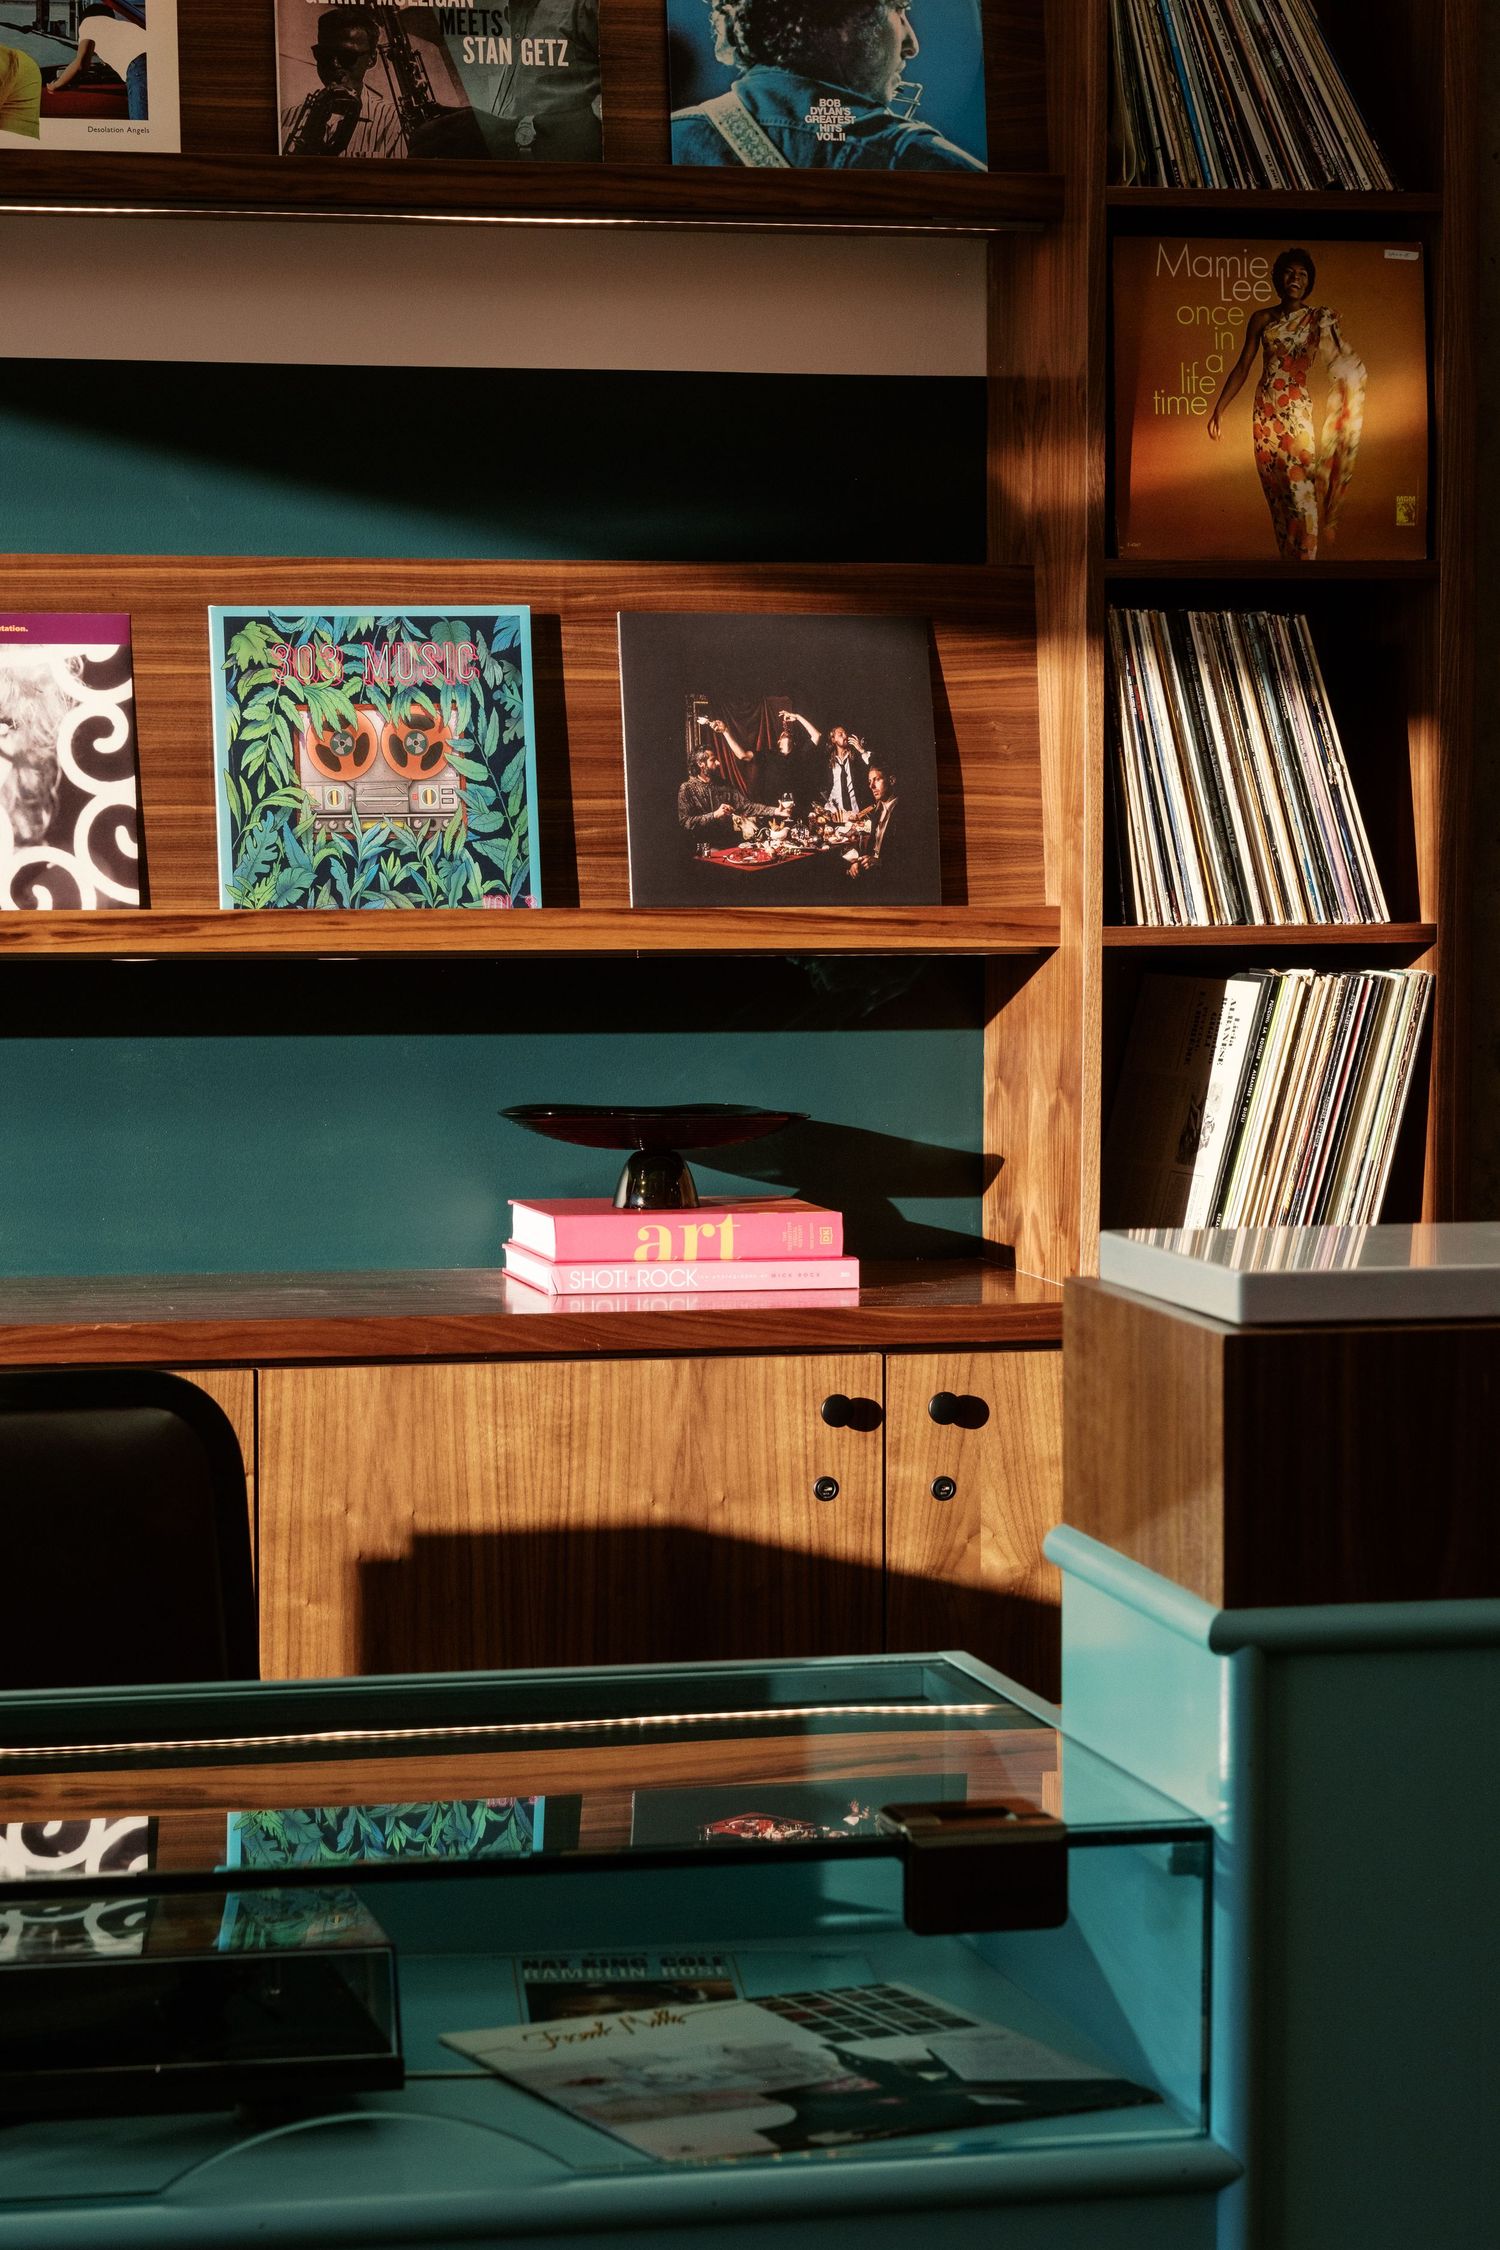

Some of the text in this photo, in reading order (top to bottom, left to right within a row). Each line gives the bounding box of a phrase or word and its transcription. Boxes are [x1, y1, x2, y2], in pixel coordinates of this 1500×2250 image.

[440, 9, 504, 37] MEETS
[463, 36, 569, 67] STAN GETZ
[810, 106, 851, 116] DYLAN'S
[819, 98, 841, 107] BOB
[126, 127, 150, 135] Angels
[804, 115, 856, 124] GREATEST
[820, 123, 843, 132] HITS
[1156, 243, 1269, 279] Mamie
[1220, 267, 1272, 302] Lee
[1176, 305, 1244, 326] once
[1214, 327, 1234, 350] in
[1206, 354, 1223, 373] a
[1181, 362, 1216, 395] life
[1153, 389, 1208, 415] time
[271, 641, 480, 686] 303 MUSIC
[1216, 997, 1236, 1066] ALBANESE
[1245, 1069, 1258, 1097] ALBANESE
[633, 1214, 741, 1261] art
[822, 1229, 830, 1242] DK
[569, 1269, 629, 1290] SHOT!
[637, 1268, 698, 1288] ROCK
